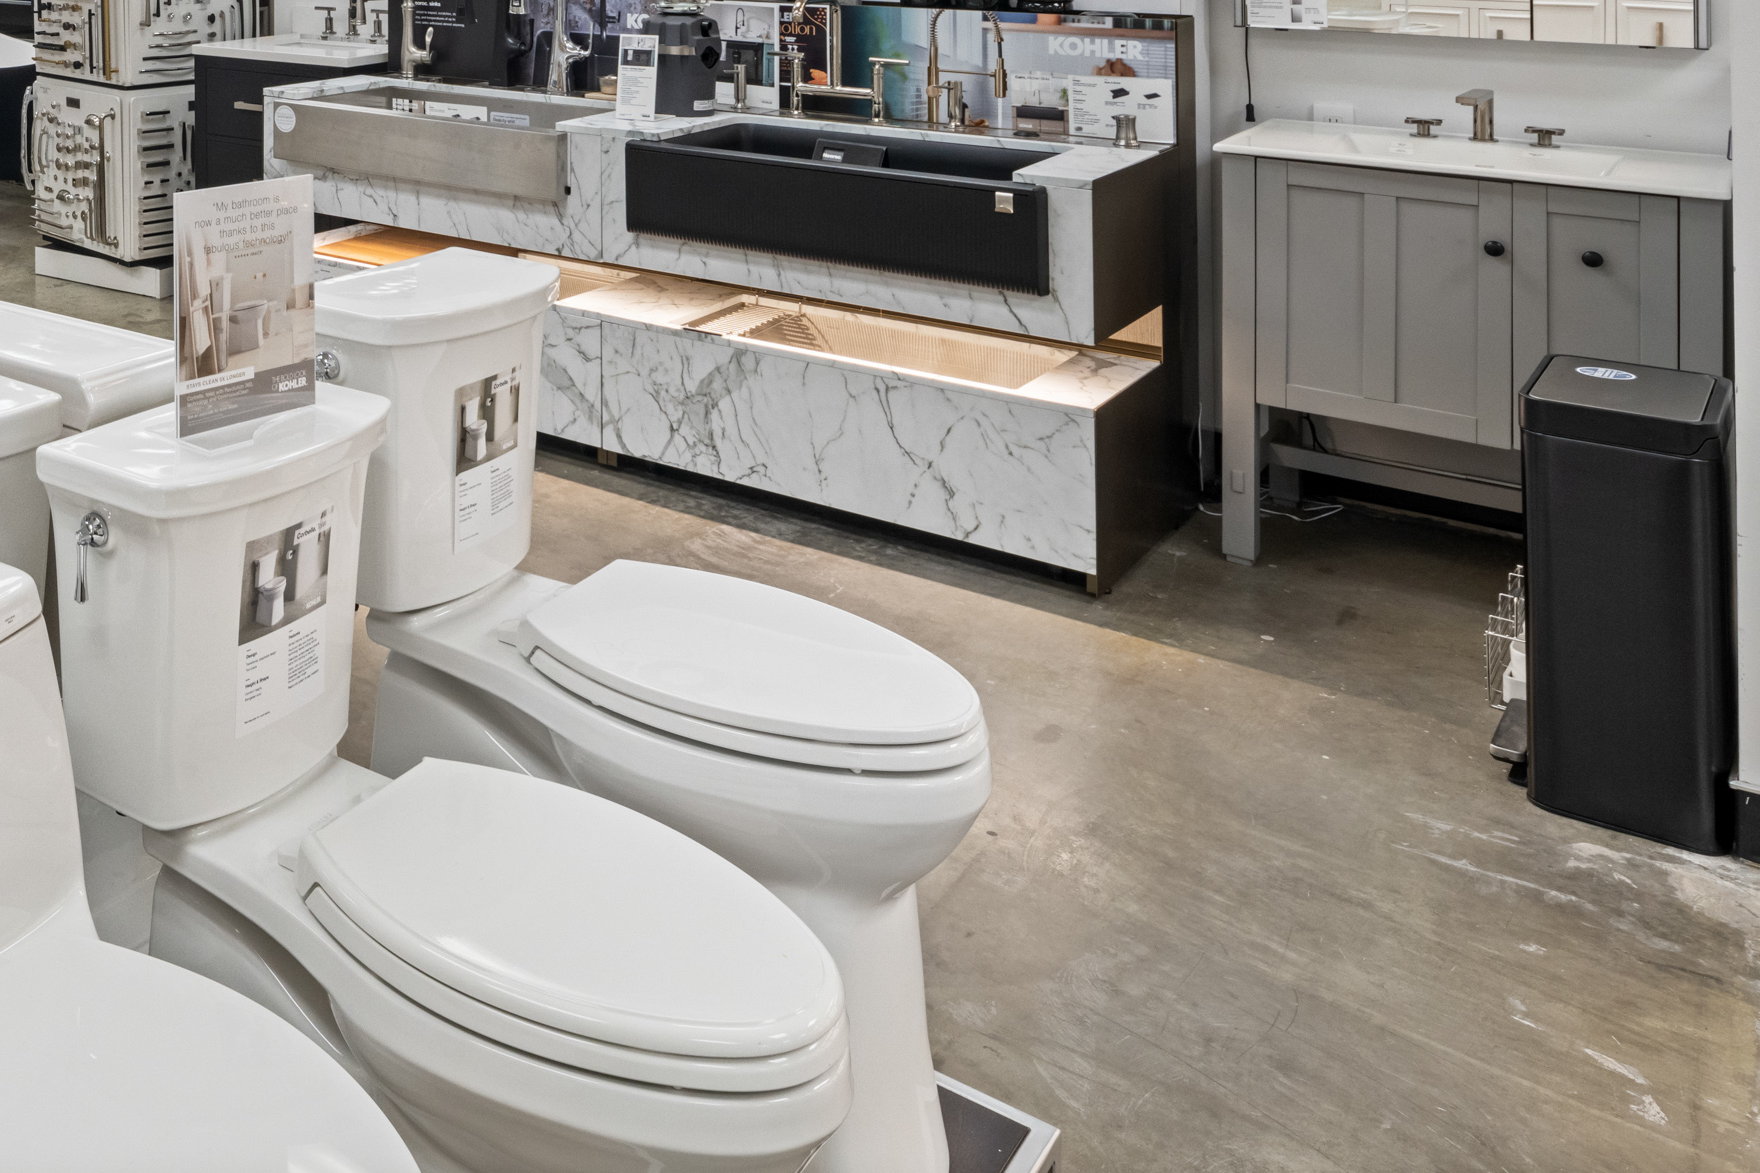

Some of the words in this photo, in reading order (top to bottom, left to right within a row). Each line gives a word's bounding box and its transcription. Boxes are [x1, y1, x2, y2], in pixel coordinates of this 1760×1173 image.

[1048, 36, 1143, 60] KOHLER
[231, 197, 270, 210] bathroom
[273, 195, 280, 203] is
[194, 219, 212, 229] now
[215, 218, 221, 226] a
[224, 213, 247, 225] much
[250, 209, 273, 221] better
[276, 205, 298, 218] place
[219, 228, 247, 239] thanks
[250, 225, 258, 233] to
[261, 222, 275, 232] this
[204, 241, 240, 255] fabulous
[186, 381, 201, 390] STAYS
[202, 378, 219, 386] CLEAN
[226, 371, 246, 381] LONGER
[279, 376, 307, 392] KOHLER
